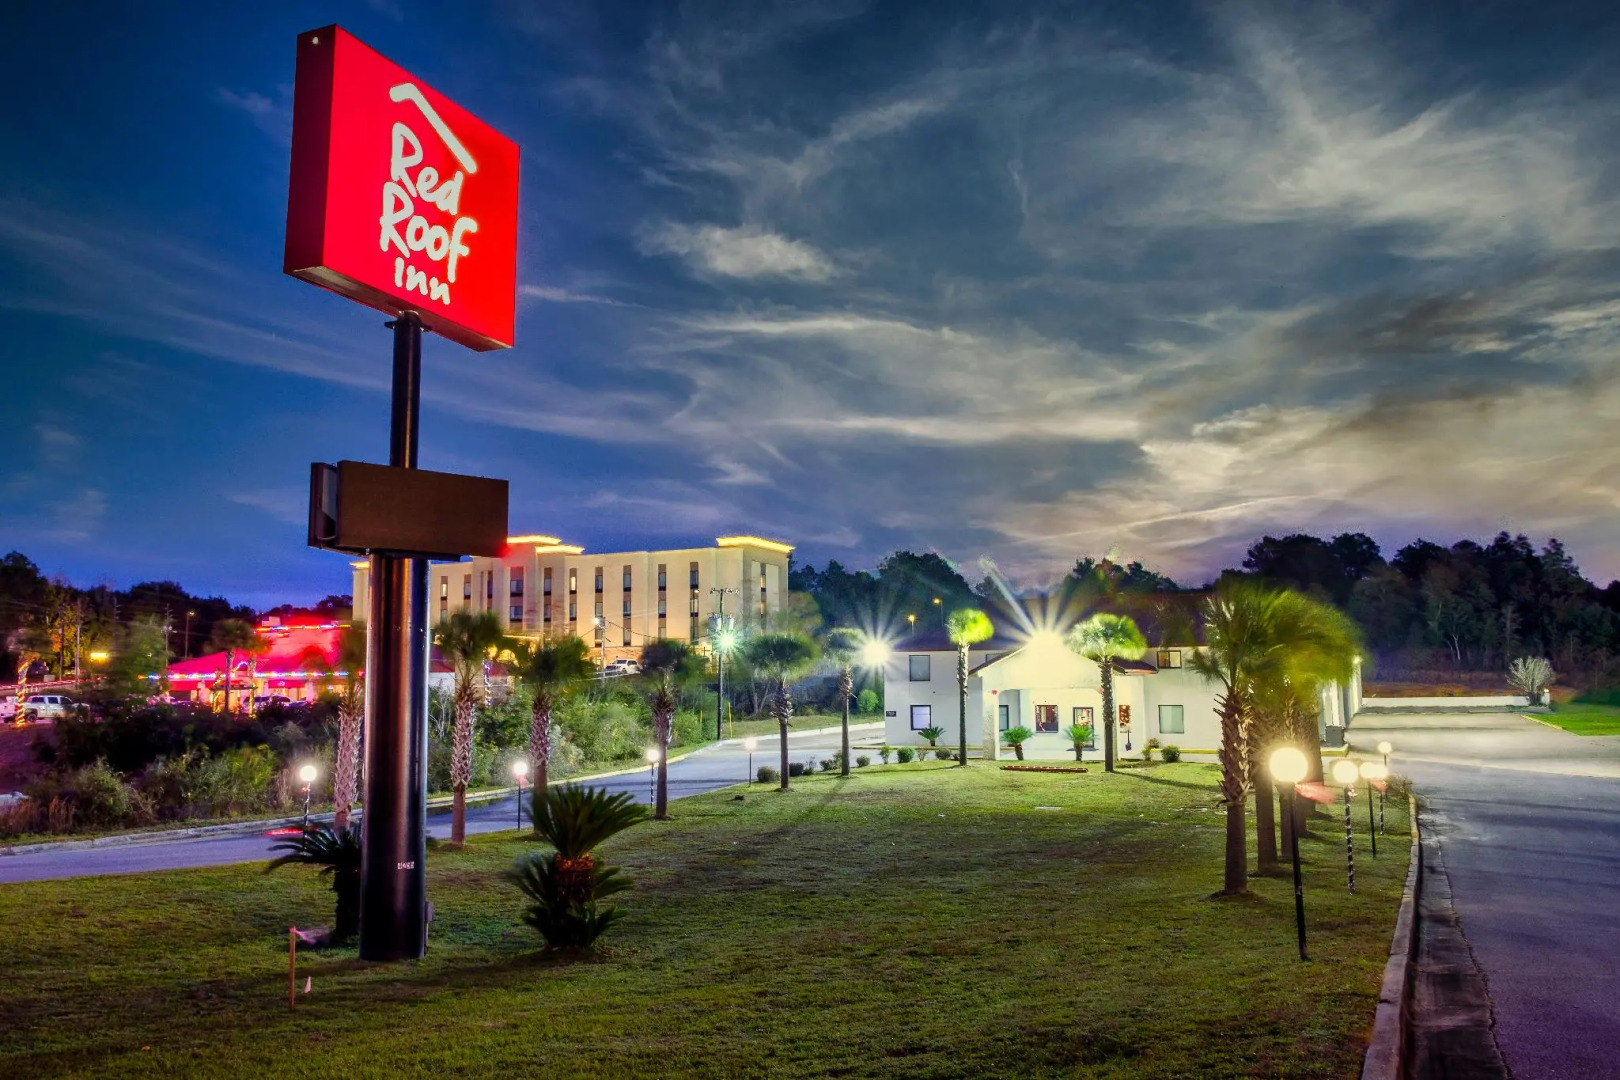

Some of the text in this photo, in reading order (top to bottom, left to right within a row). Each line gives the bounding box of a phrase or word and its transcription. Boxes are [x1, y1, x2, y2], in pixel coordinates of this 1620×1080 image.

[391, 122, 462, 215] Red
[380, 182, 477, 283] Roof
[395, 257, 450, 305] Inn
